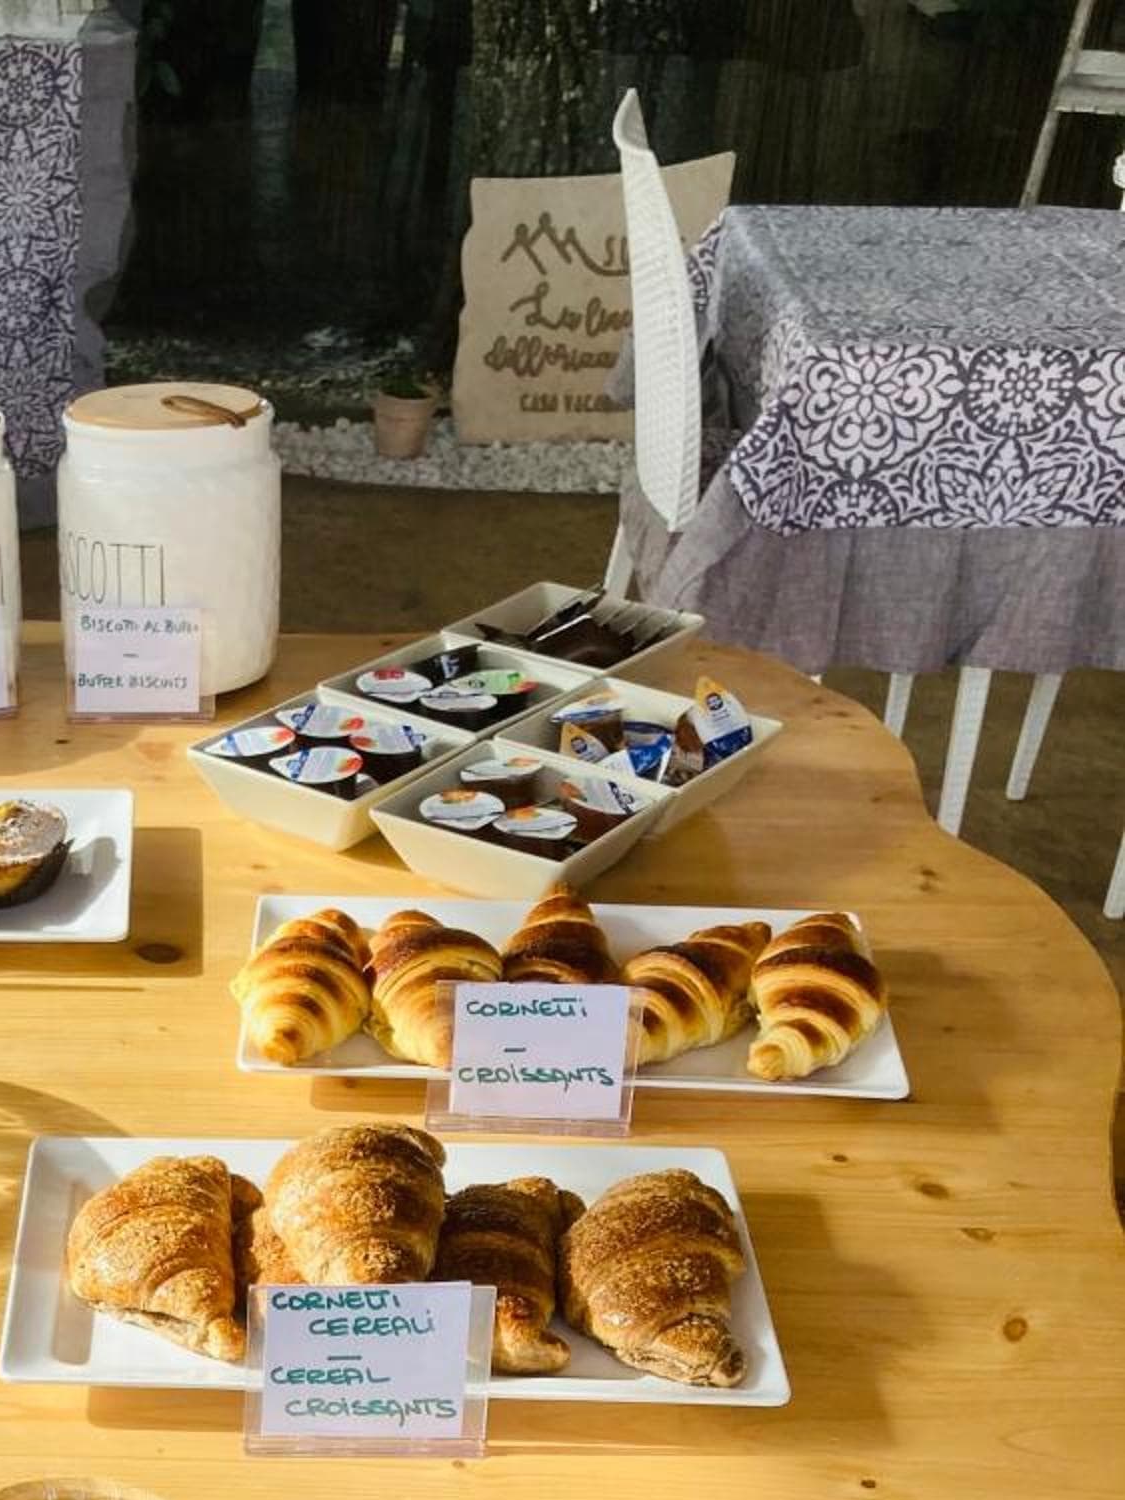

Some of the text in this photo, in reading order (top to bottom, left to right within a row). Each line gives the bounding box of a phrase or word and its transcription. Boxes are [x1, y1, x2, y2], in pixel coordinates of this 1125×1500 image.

[466, 997, 588, 1018] CORNETTI
[271, 1289, 401, 1311] CORNETTI
[270, 1366, 391, 1385] CEREAL
